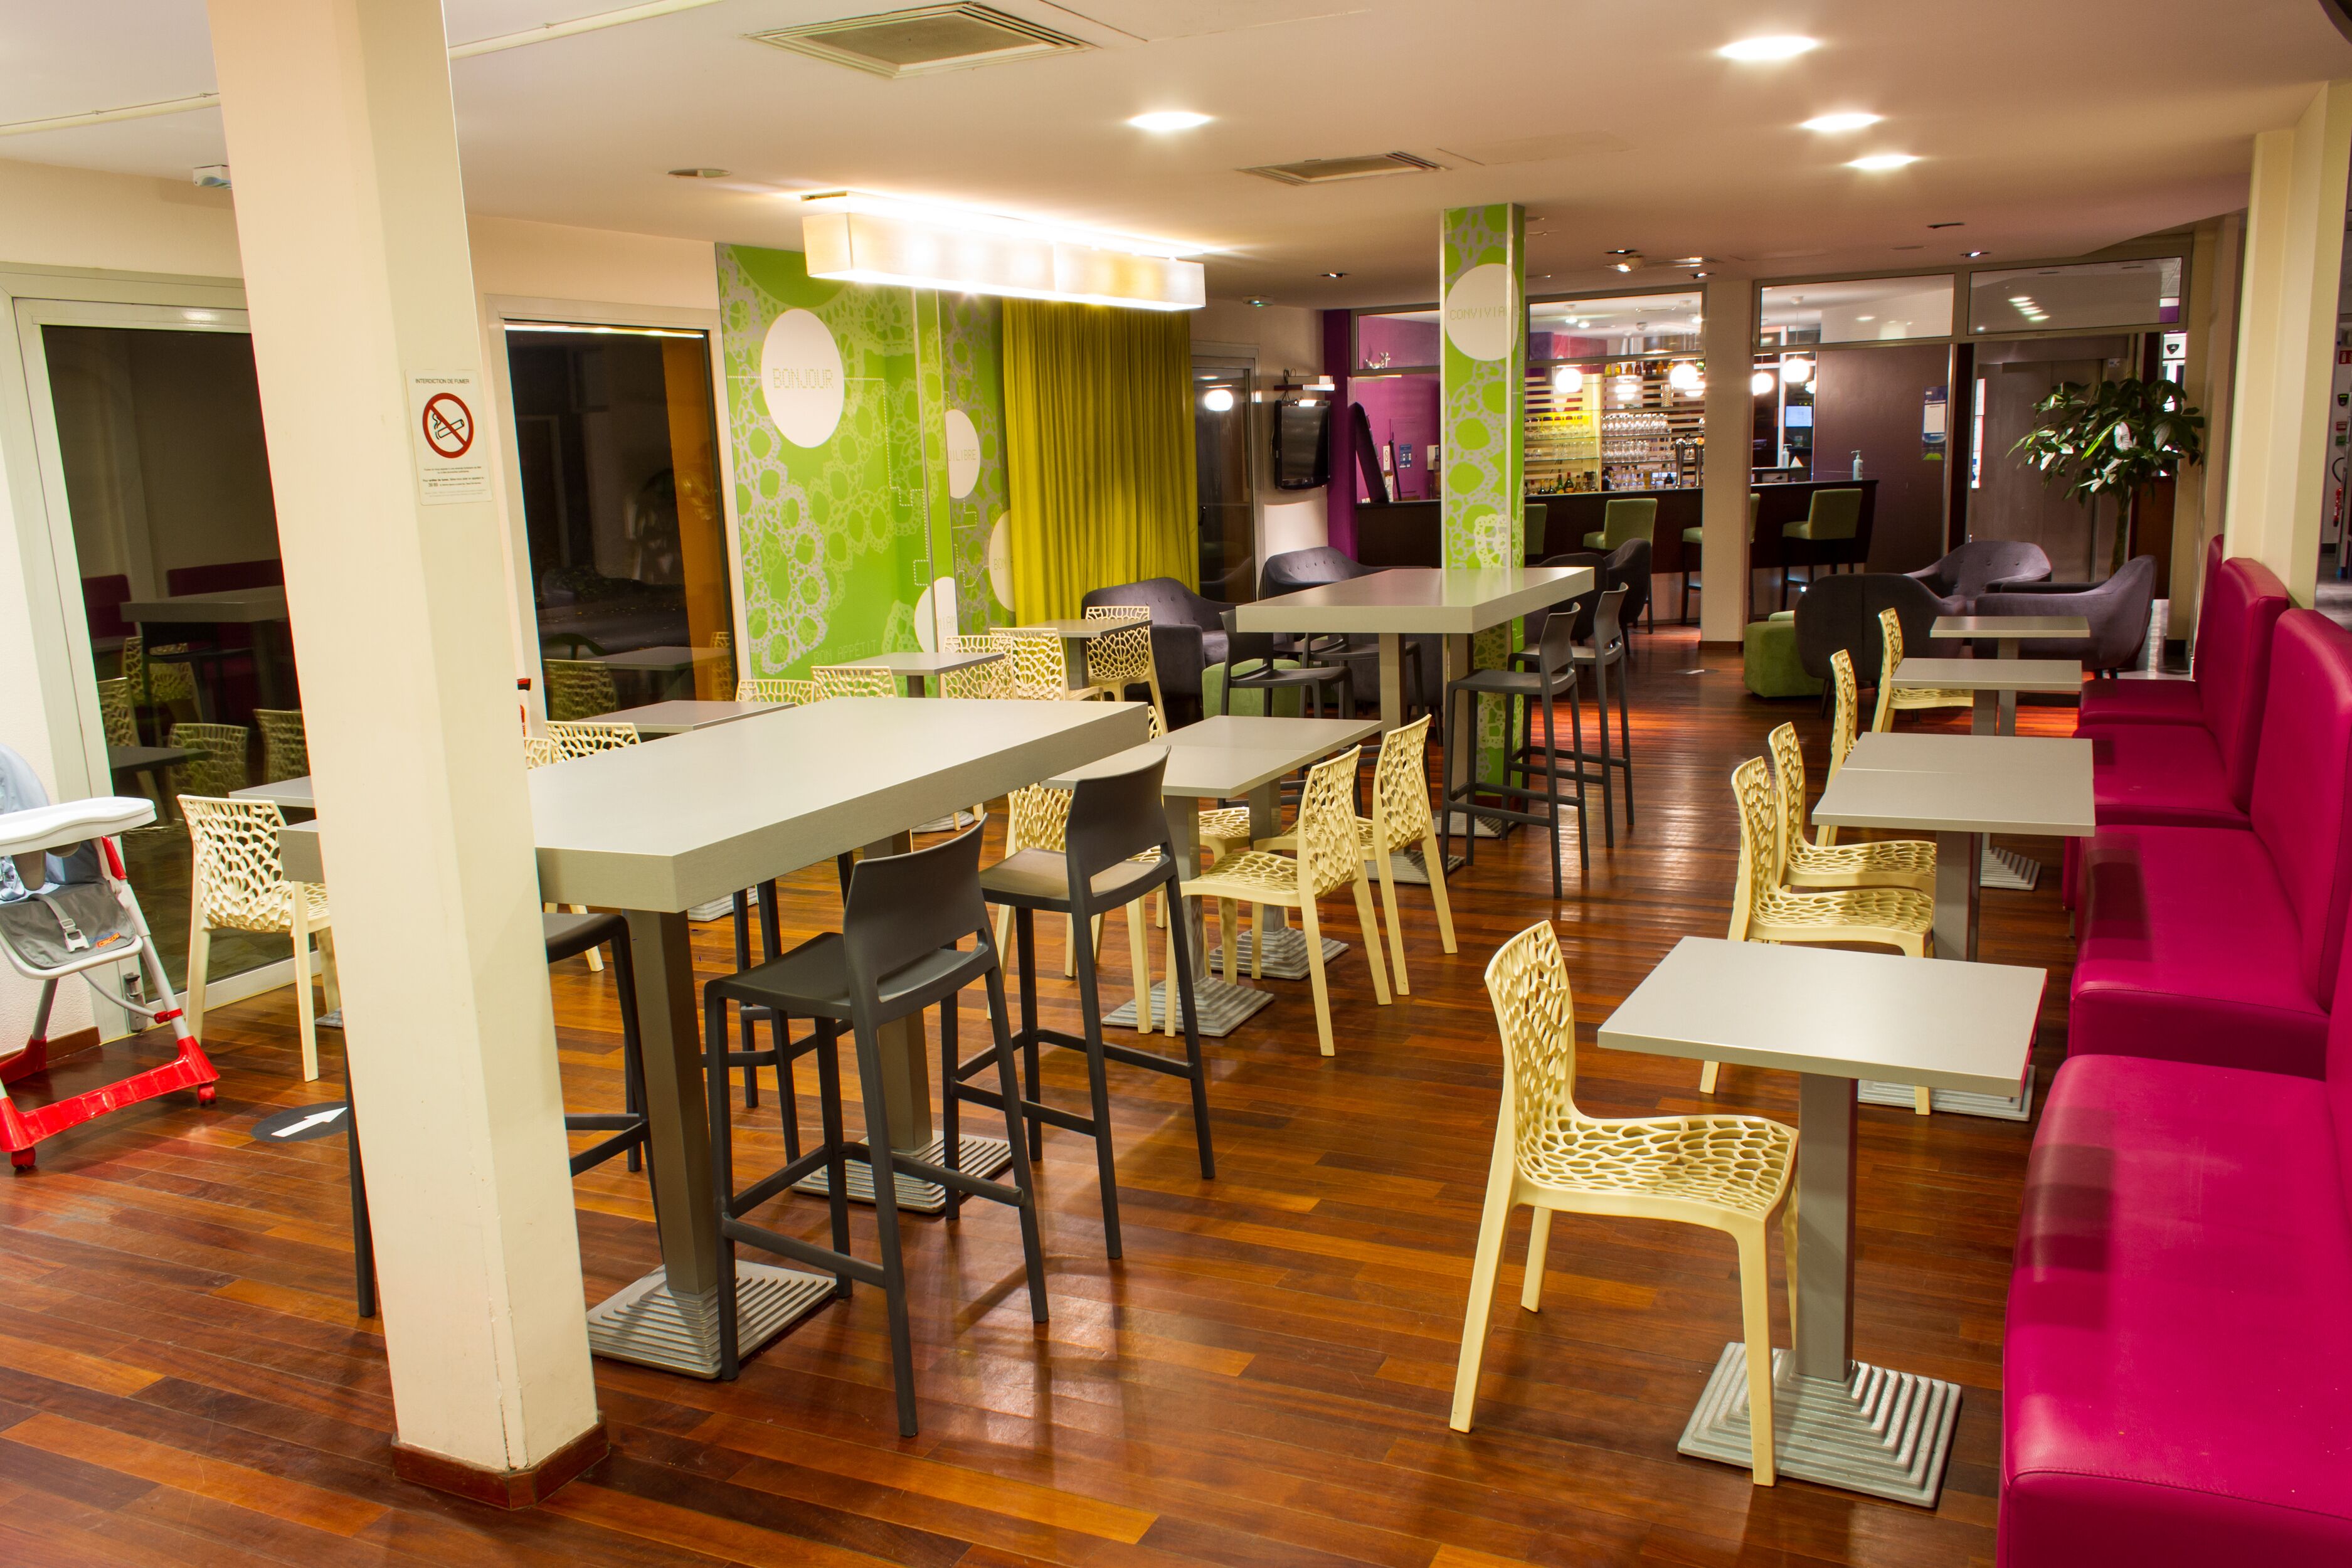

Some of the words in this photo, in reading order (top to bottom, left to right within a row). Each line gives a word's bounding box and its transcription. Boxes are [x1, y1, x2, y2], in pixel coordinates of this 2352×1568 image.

[1449, 305, 1518, 320] CONVIVIA
[772, 368, 834, 389] BONJOUR
[813, 649, 833, 665] BON
[837, 639, 877, 661] APPÉTIT
